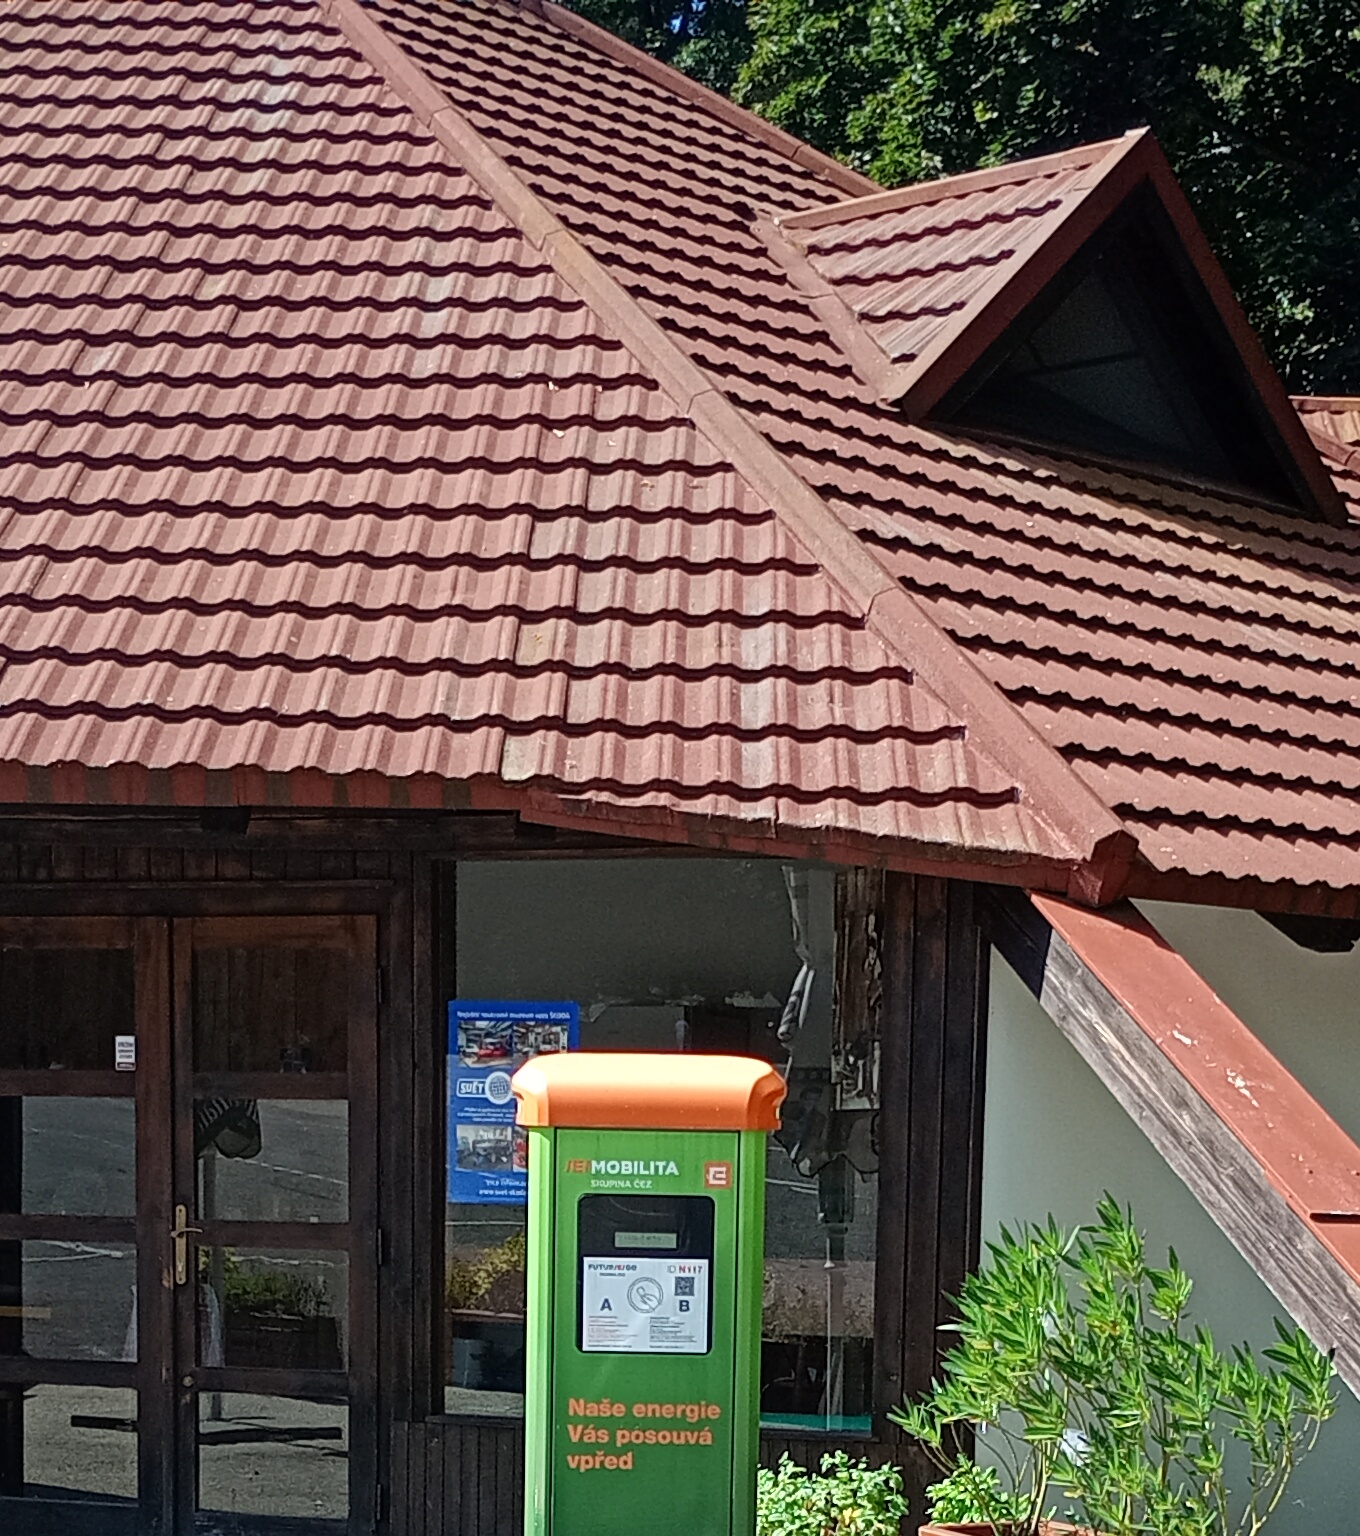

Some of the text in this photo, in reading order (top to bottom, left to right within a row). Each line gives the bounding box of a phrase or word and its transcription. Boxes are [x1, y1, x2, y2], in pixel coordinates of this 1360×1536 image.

[590, 1180, 632, 1189] SKUPINA
[600, 1298, 613, 1312] A
[678, 1300, 690, 1312] B
[568, 1398, 722, 1423] Naše energie
[567, 1424, 713, 1447] Vás posouvá
[567, 1450, 633, 1473] vpřed
